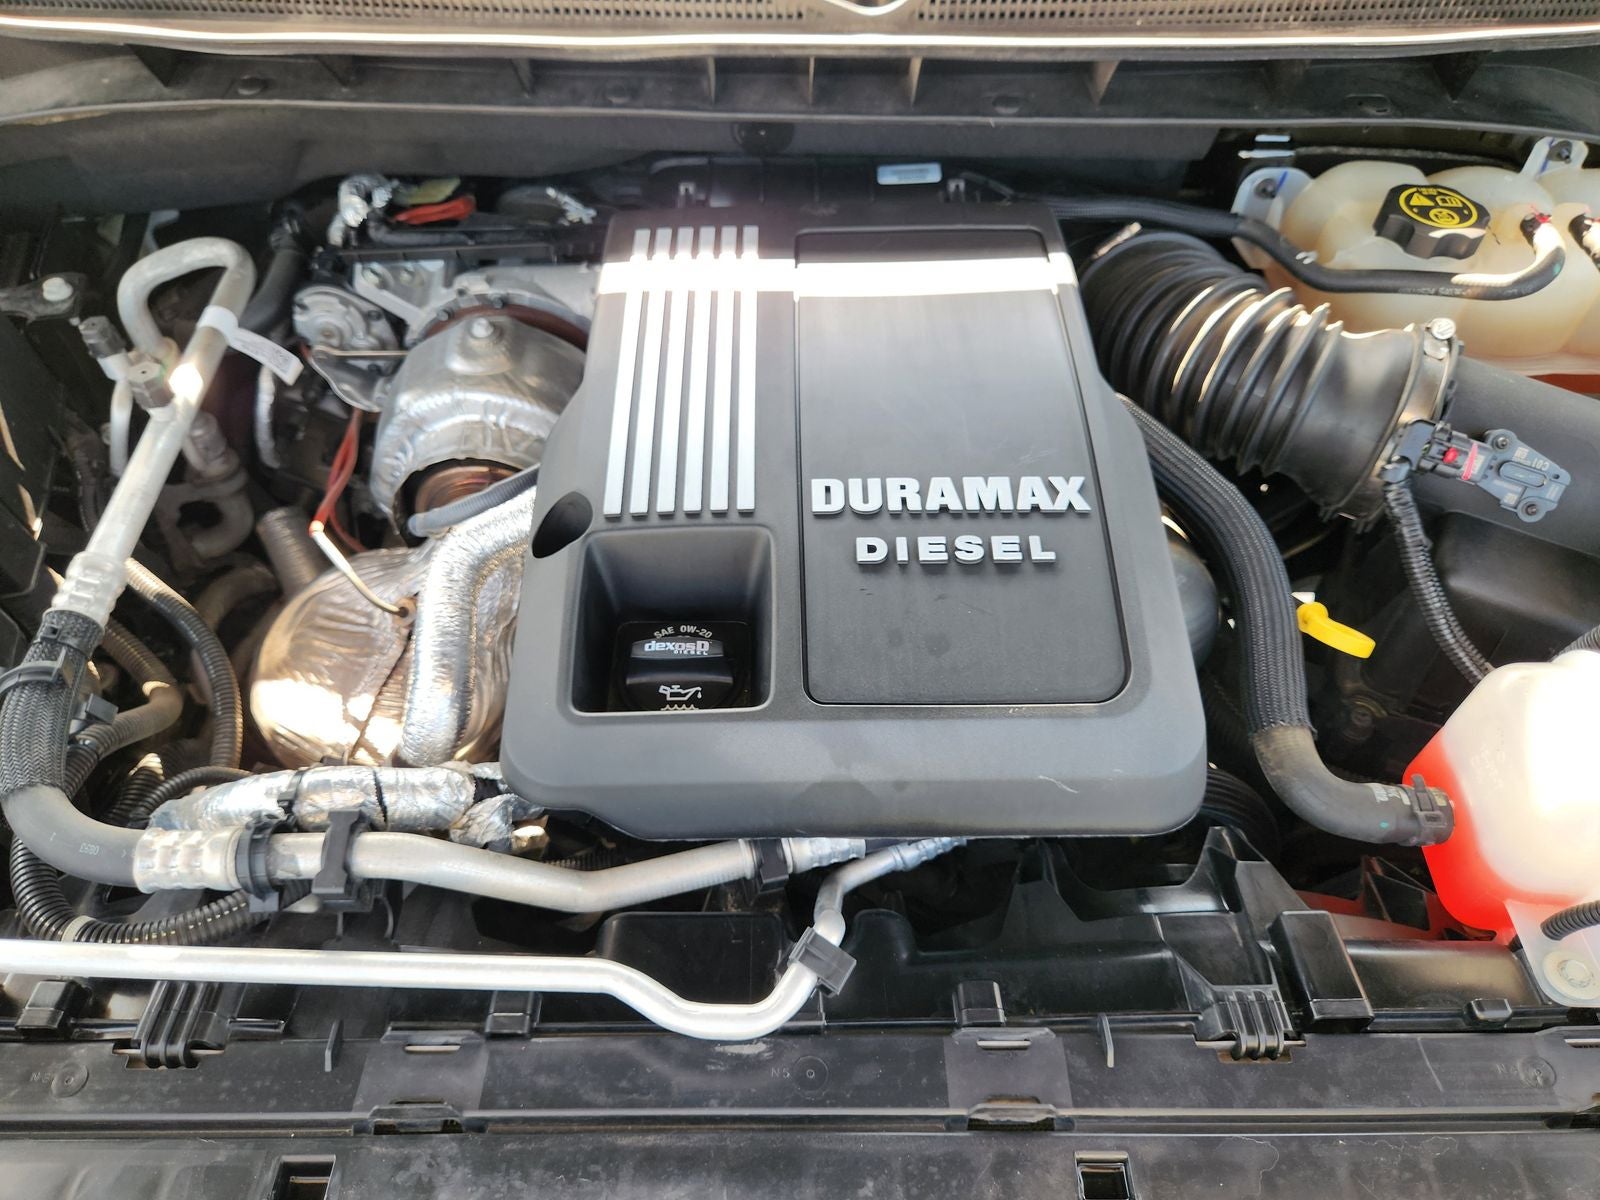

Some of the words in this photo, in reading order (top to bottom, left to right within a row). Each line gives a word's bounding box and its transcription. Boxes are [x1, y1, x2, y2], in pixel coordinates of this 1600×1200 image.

[811, 476, 1092, 514] DURAMAX
[856, 535, 1057, 565] DIESEL
[654, 627, 674, 638] SAE
[680, 625, 713, 638] 0W-20
